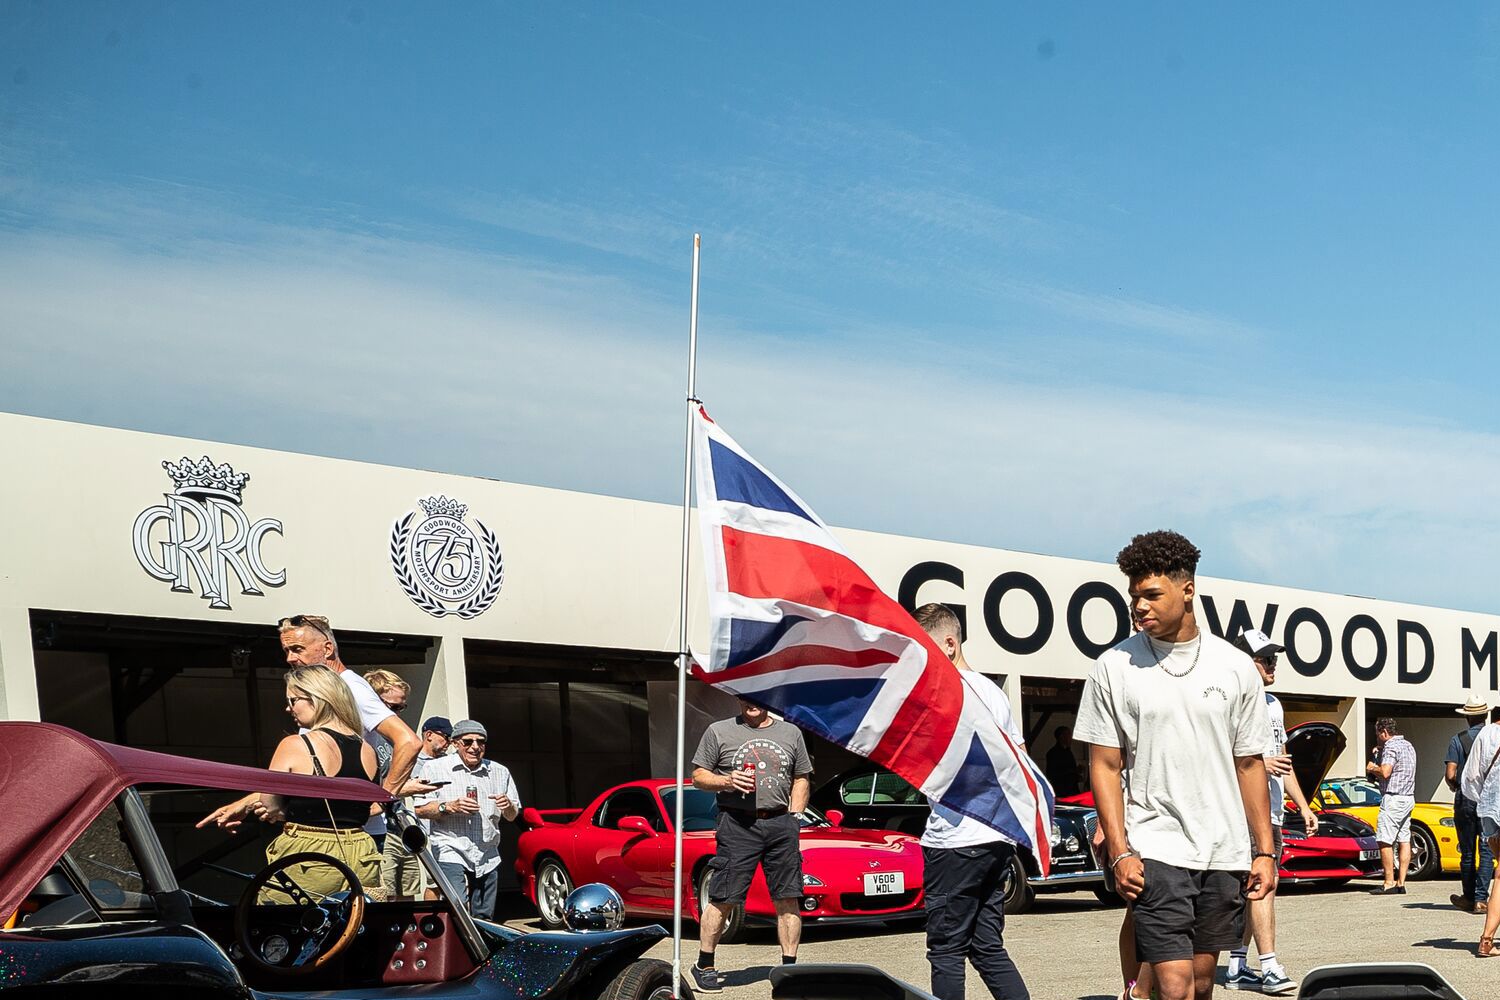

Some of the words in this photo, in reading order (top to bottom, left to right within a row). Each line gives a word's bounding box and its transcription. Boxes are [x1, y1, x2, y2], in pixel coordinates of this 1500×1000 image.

[424, 519, 467, 535] GOODWOOD
[132, 493, 287, 610] GRRC
[416, 532, 474, 583] 75
[414, 550, 449, 596] MOTORSPORT
[452, 555, 480, 596] ANNIVERSARY
[873, 874, 895, 884] V608
[876, 884, 893, 893] MDL
